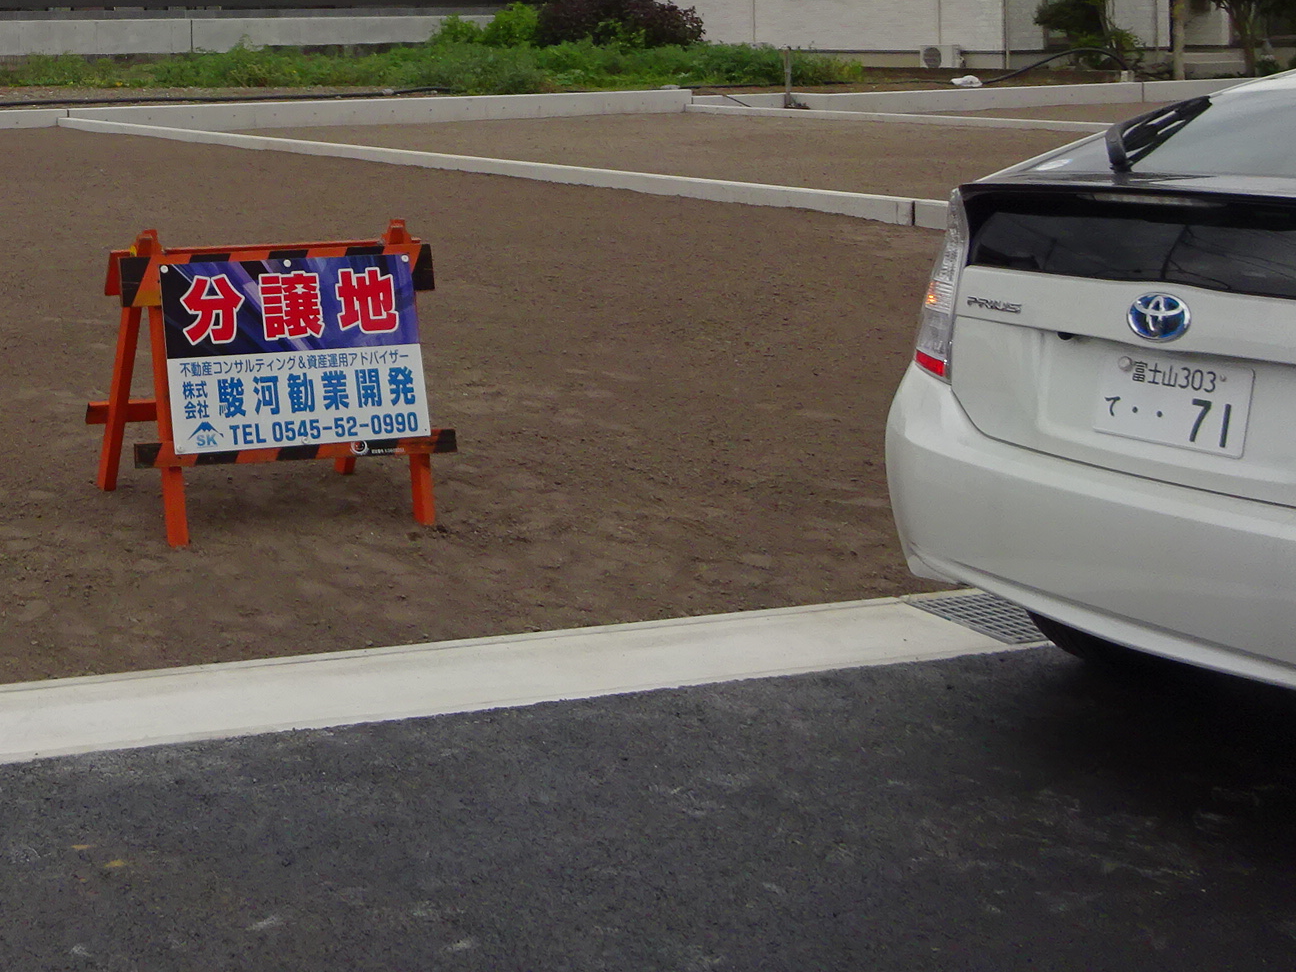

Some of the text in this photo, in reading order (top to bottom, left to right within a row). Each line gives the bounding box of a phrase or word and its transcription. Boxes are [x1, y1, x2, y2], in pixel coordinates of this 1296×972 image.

[180, 267, 399, 345] 分譲地
[196, 434, 218, 447] SK
[229, 412, 418, 445] TEL 0545-52-0990
